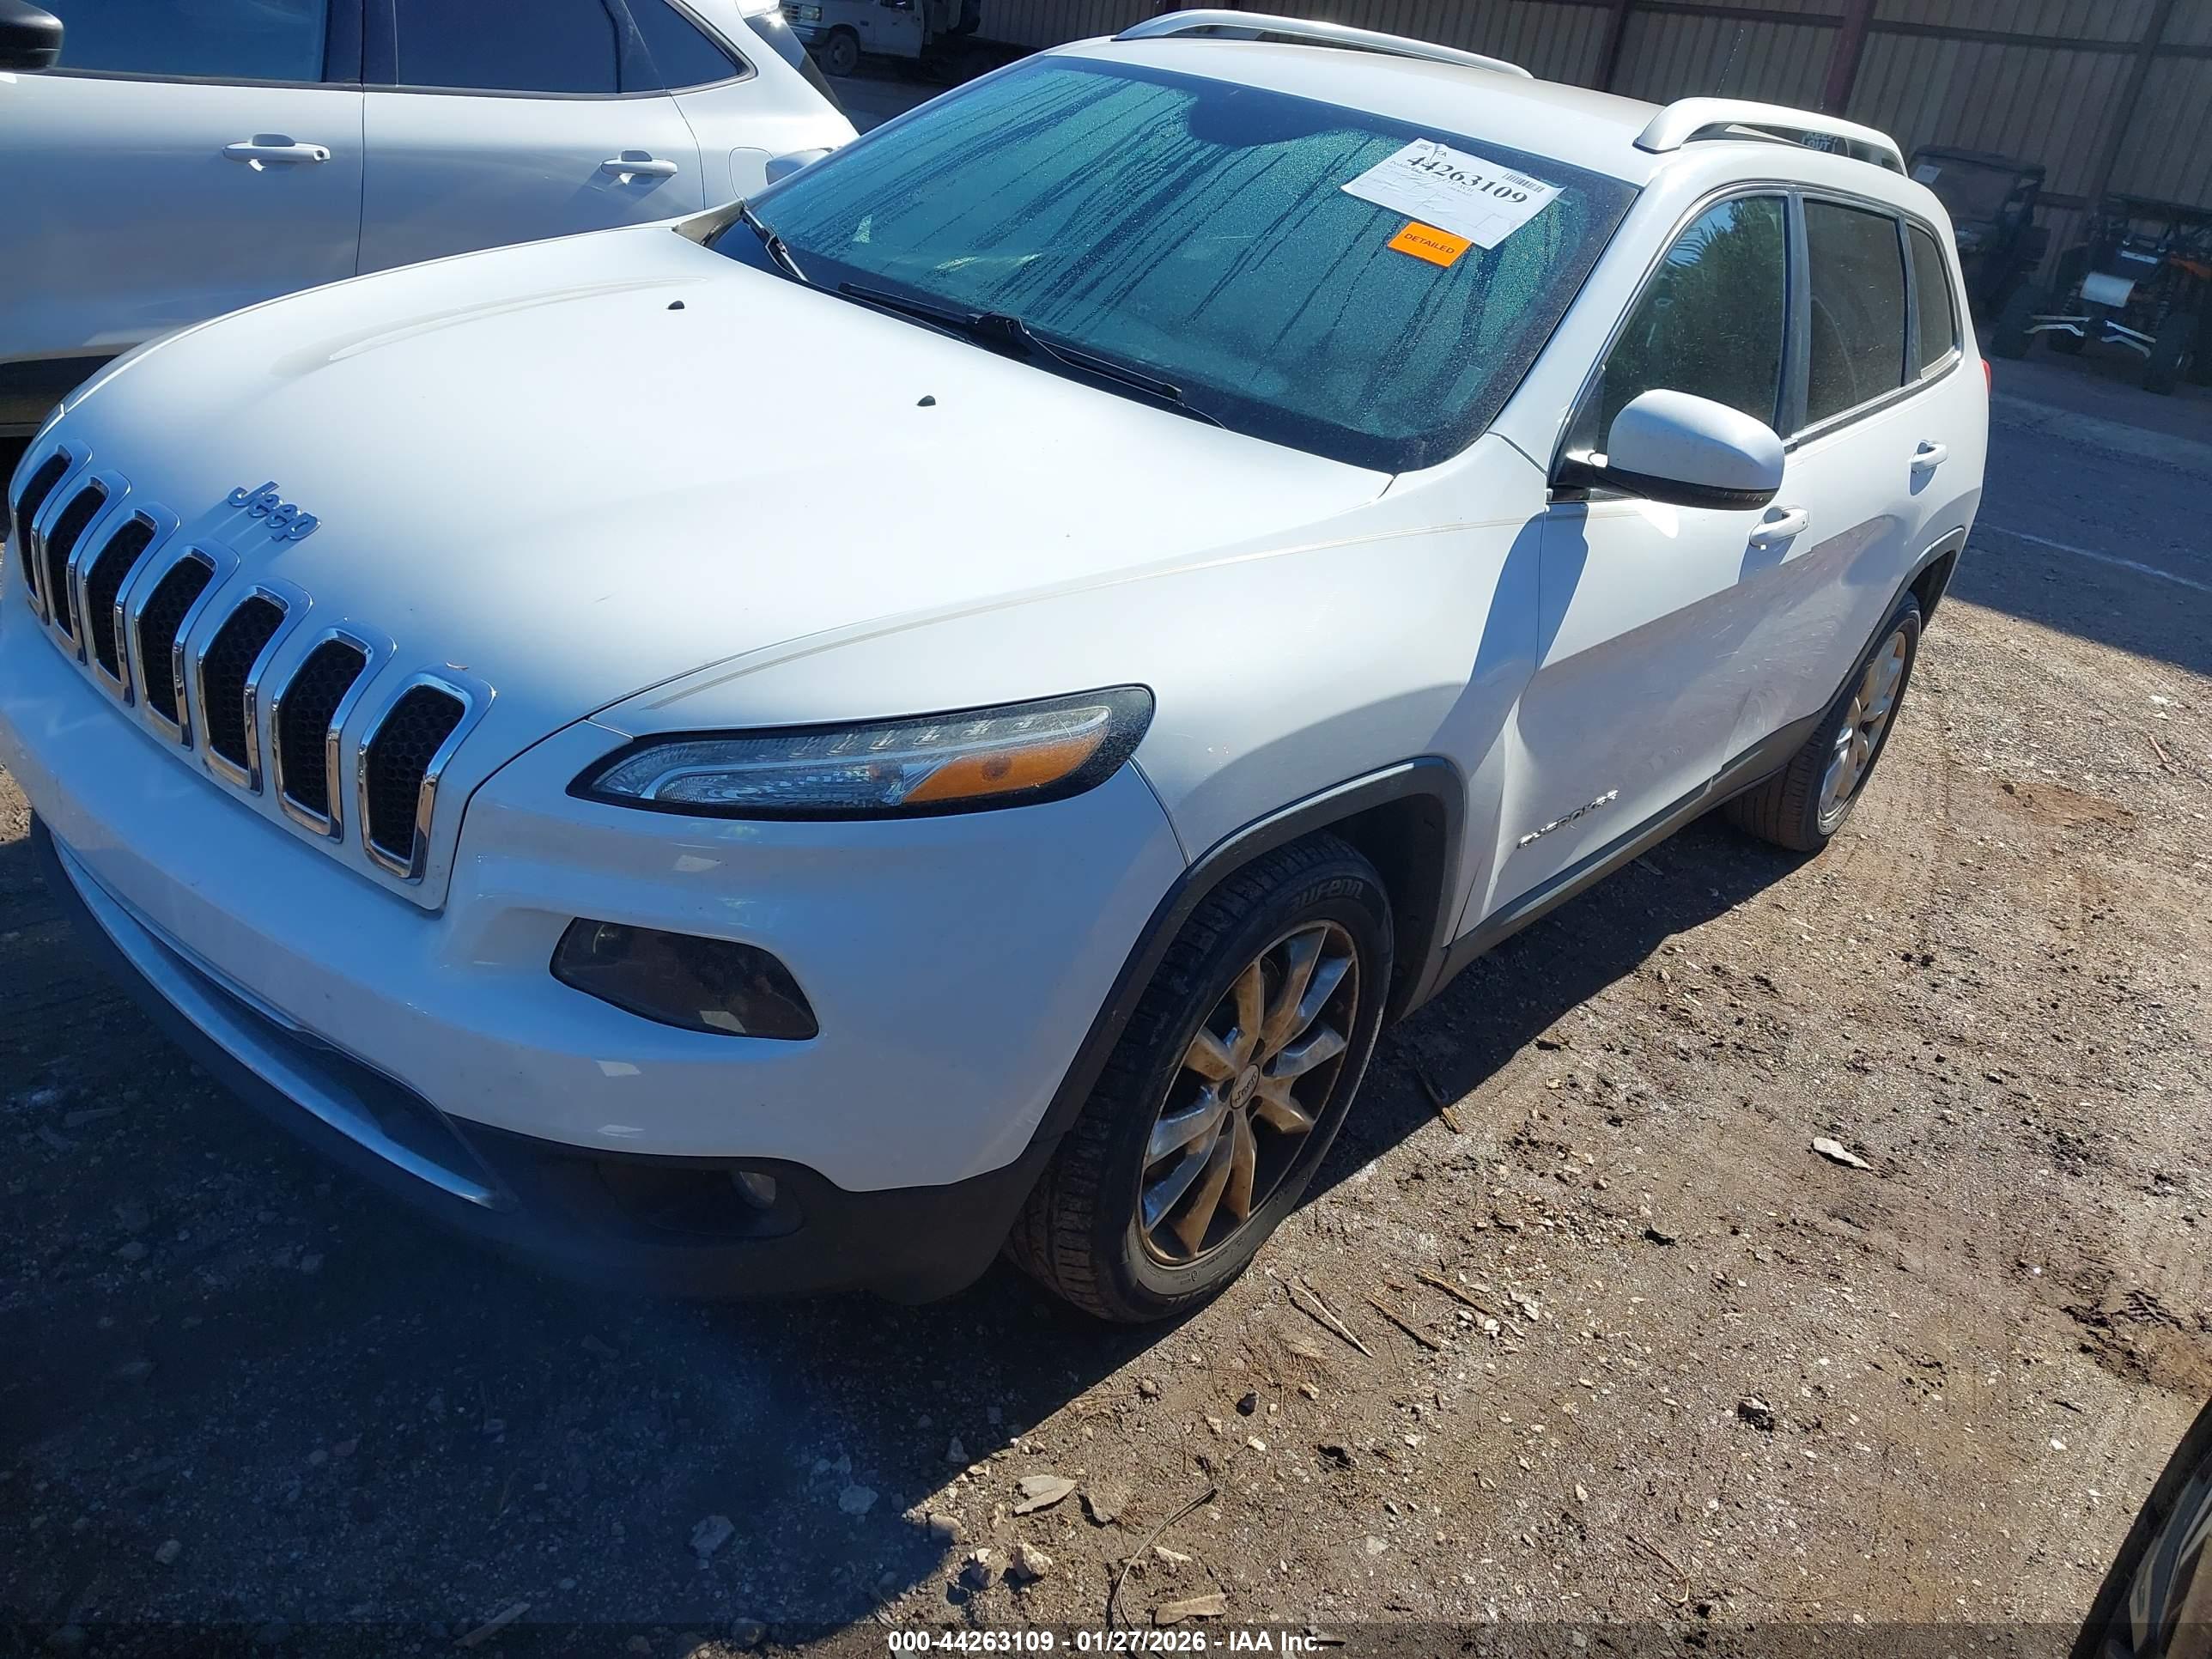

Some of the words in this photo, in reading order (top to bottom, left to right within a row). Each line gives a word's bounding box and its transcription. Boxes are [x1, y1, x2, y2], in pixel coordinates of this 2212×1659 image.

[1407, 156, 1528, 204] 44263109
[1403, 233, 1455, 255] DETAILED
[227, 480, 321, 543] Jeep
